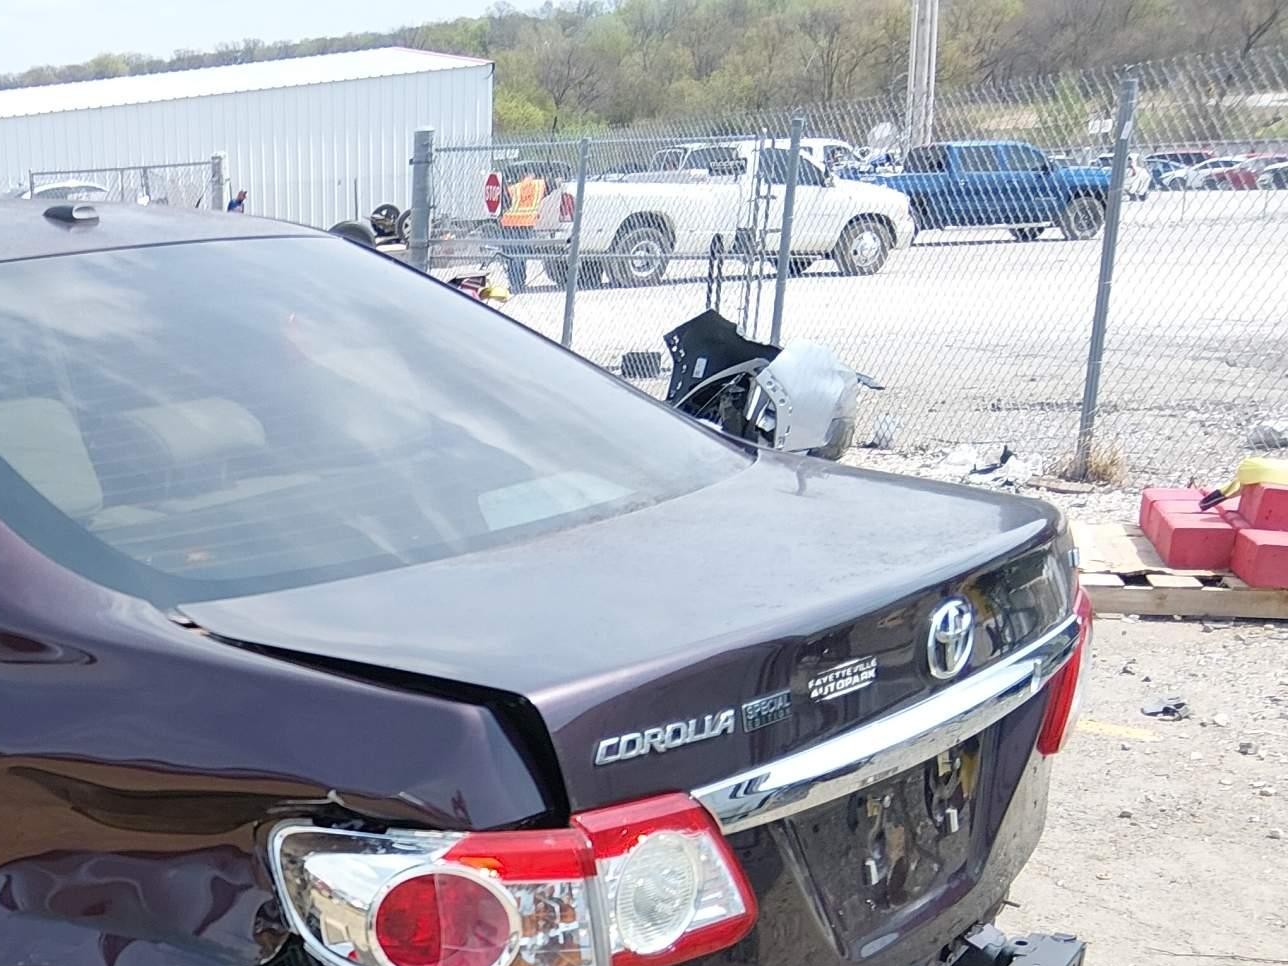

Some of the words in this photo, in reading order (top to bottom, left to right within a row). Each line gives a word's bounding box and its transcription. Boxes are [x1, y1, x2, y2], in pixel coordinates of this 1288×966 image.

[485, 185, 500, 201] STOP
[810, 667, 876, 698] AUTOPARK
[746, 693, 791, 720] SPECIAL
[595, 709, 736, 766] COROLLA
